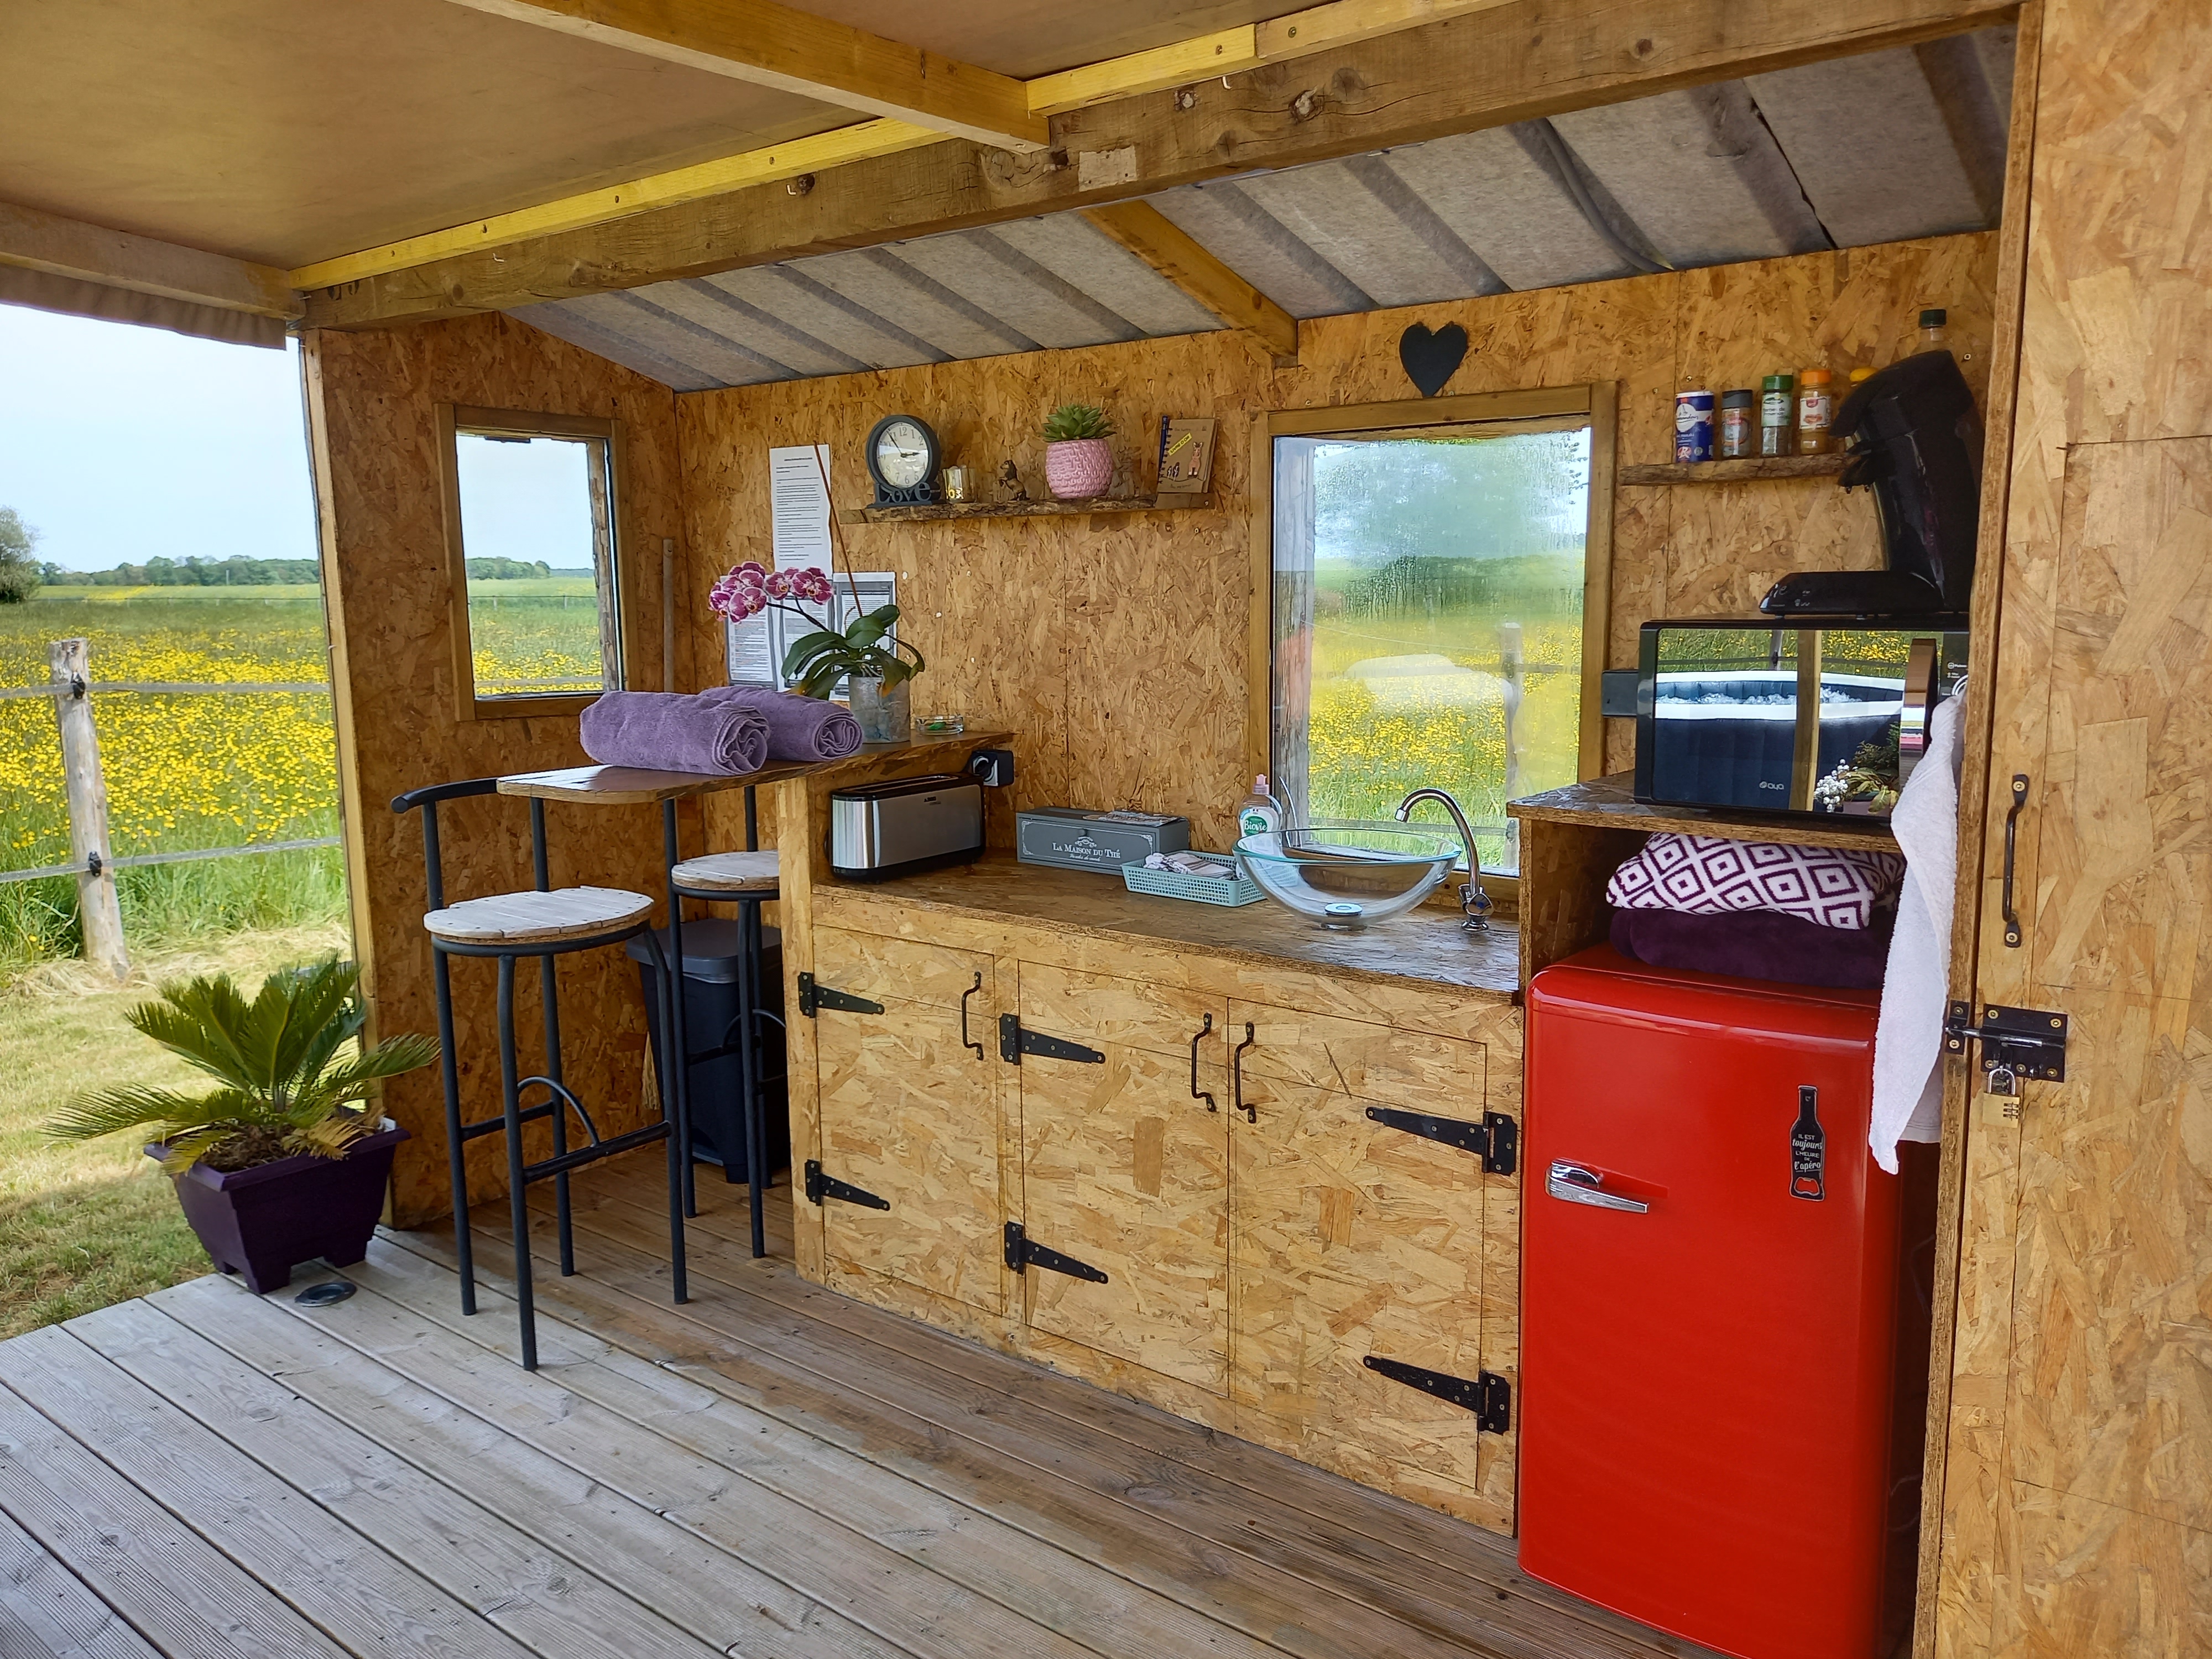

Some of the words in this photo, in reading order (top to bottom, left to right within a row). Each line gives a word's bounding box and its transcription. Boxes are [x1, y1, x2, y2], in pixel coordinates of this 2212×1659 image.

[899, 426, 907, 437] 12
[911, 429, 915, 439] 1
[919, 436, 924, 446] 2
[895, 472, 900, 482] 7
[905, 474, 910, 484] 6
[914, 471, 919, 481] 5
[1244, 820, 1267, 831] Biovie
[1052, 842, 1063, 851] LA
[1064, 844, 1092, 855] MAISON
[1792, 1138, 1822, 1151] toujours
[1794, 1161, 1821, 1172] l'apéro
